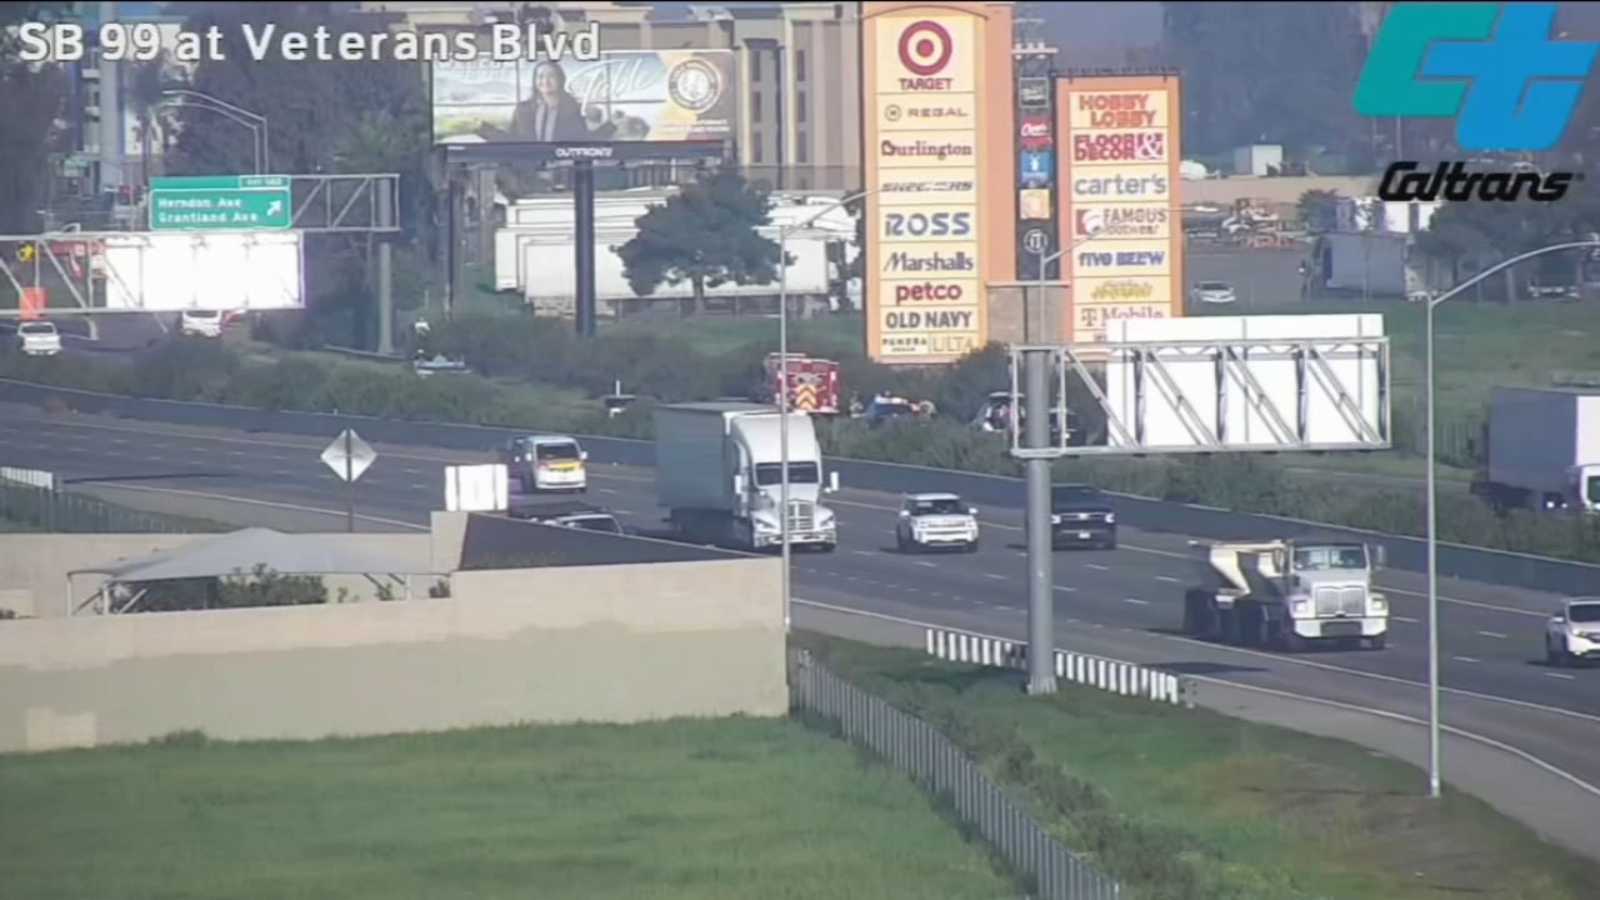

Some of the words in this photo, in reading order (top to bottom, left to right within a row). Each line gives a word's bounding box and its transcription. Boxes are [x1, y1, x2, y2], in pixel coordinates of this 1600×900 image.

[899, 78, 952, 90] TARGET
[1079, 94, 1149, 111] HOBBY
[908, 108, 968, 117] REGAL
[1090, 110, 1157, 127] LOBBY
[881, 140, 973, 160] Burlington
[1074, 174, 1167, 195] carter's
[158, 198, 211, 208] Herndon
[159, 212, 226, 222] Grantland
[233, 212, 258, 222] Ave
[885, 212, 970, 236] ROSS
[1104, 208, 1167, 223] FAMOUS
[883, 251, 974, 271] Marshalls
[896, 281, 962, 306] petco
[885, 311, 921, 329] OLD
[925, 311, 972, 328] NAVY
[882, 337, 927, 346] PANERA
